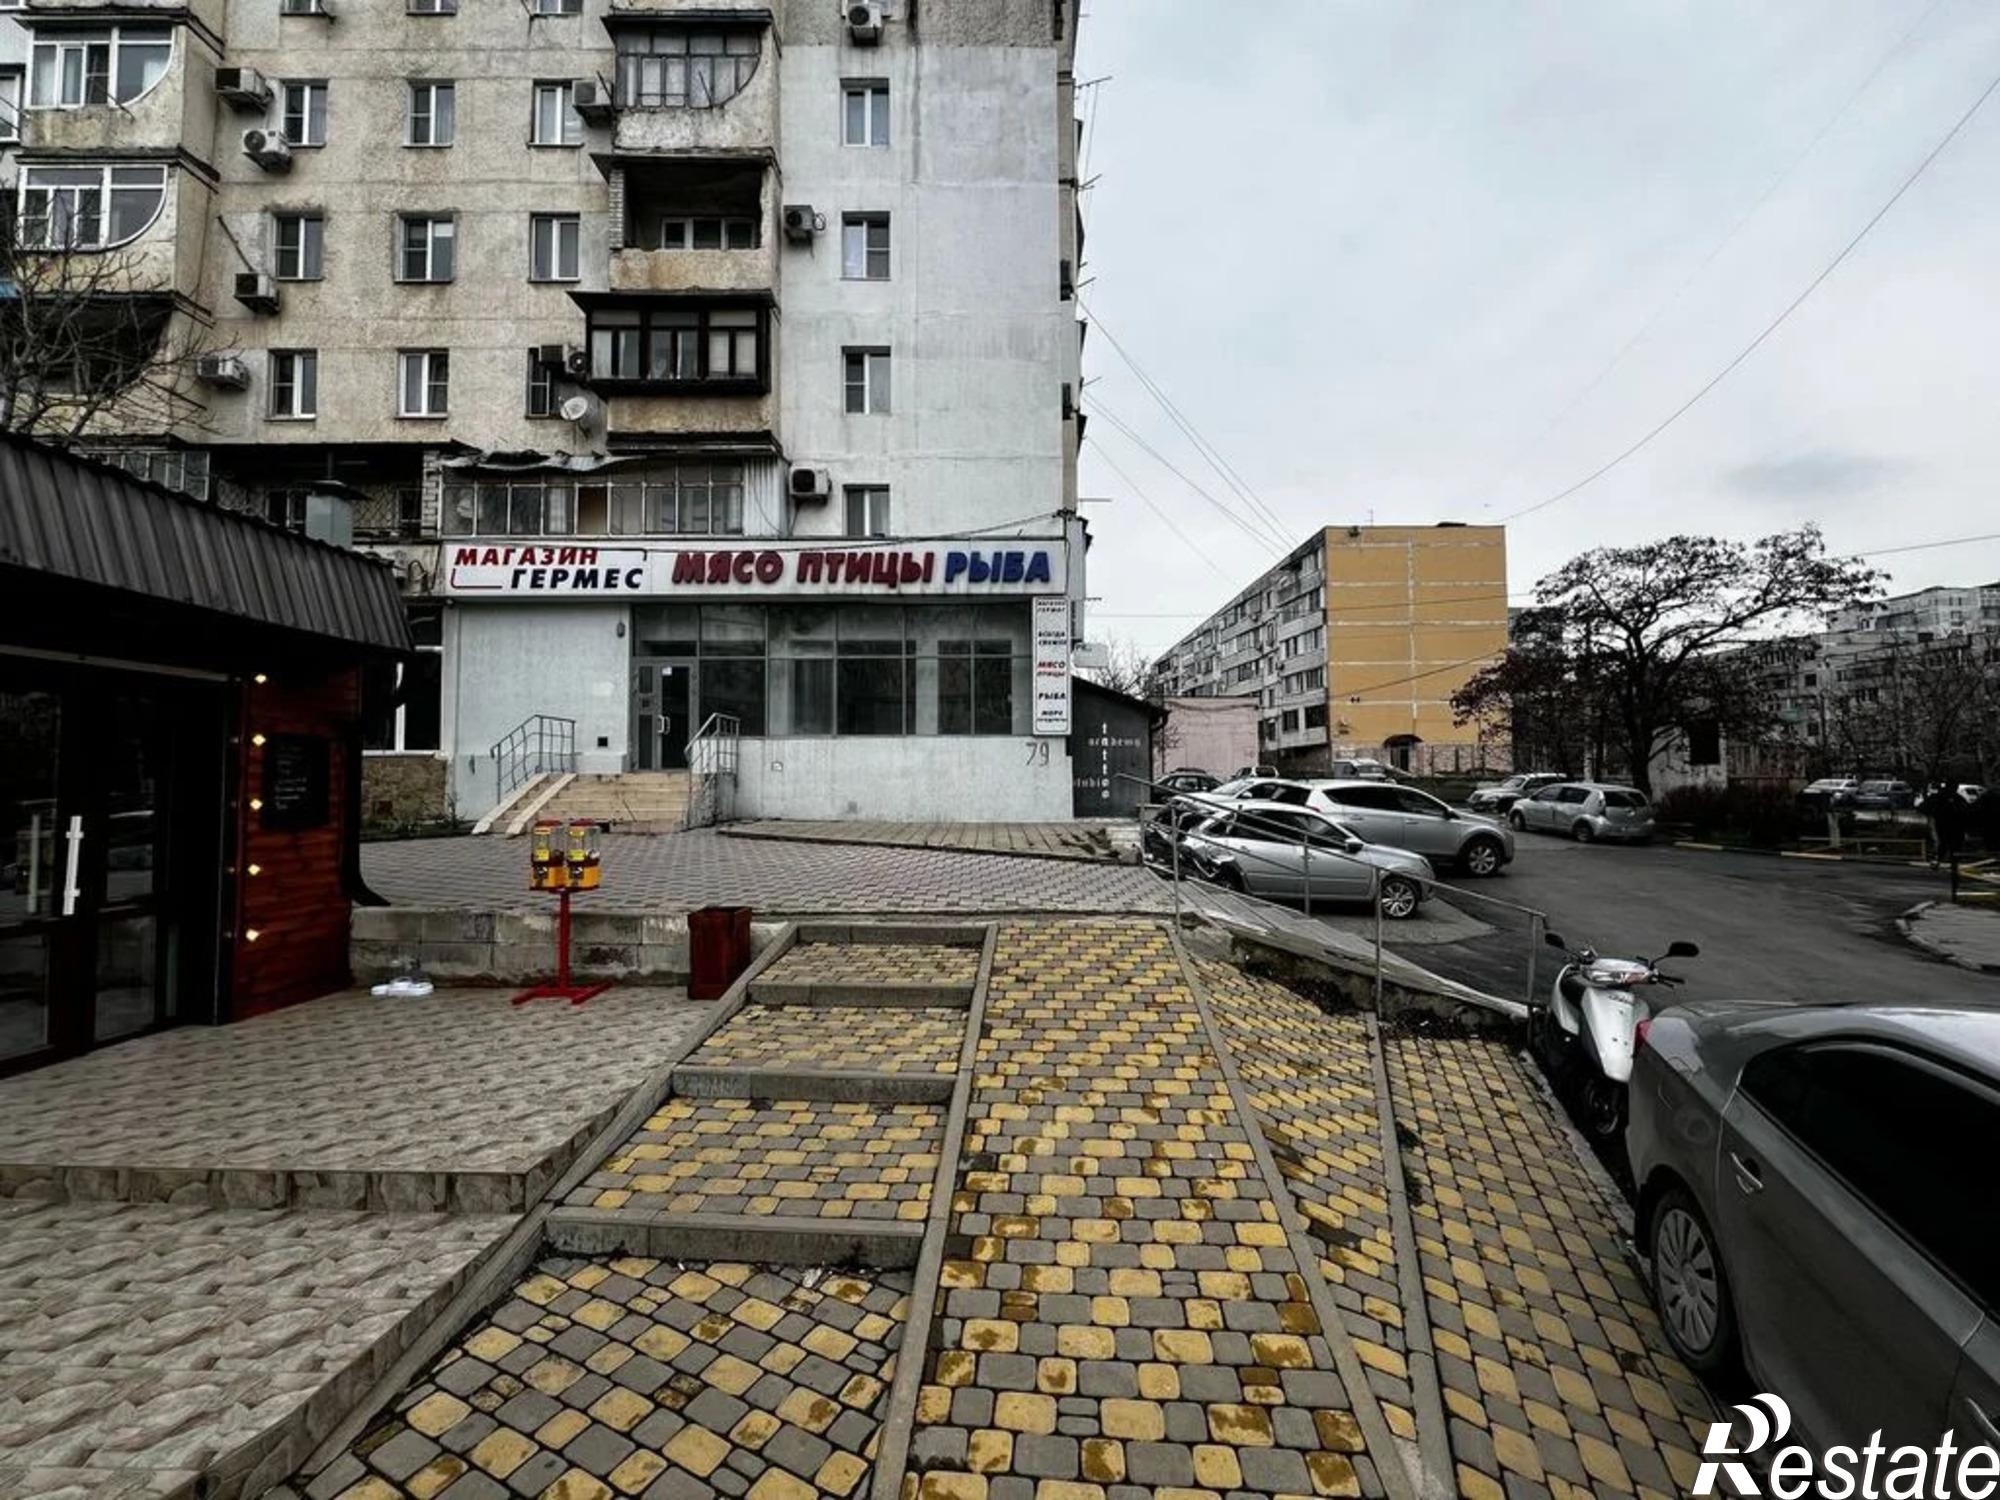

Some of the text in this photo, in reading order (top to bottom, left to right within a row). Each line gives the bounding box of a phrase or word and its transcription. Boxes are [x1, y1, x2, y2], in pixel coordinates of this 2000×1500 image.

[454, 548, 599, 566] МАГАЗИН
[510, 568, 643, 590] ГЕРМЕС
[672, 551, 1051, 588] МЯСО ПТИЦЫ РЫБА
[1038, 661, 1066, 669] МЯСО
[1038, 692, 1066, 700] РЫБА
[1026, 741, 1050, 767] 79
